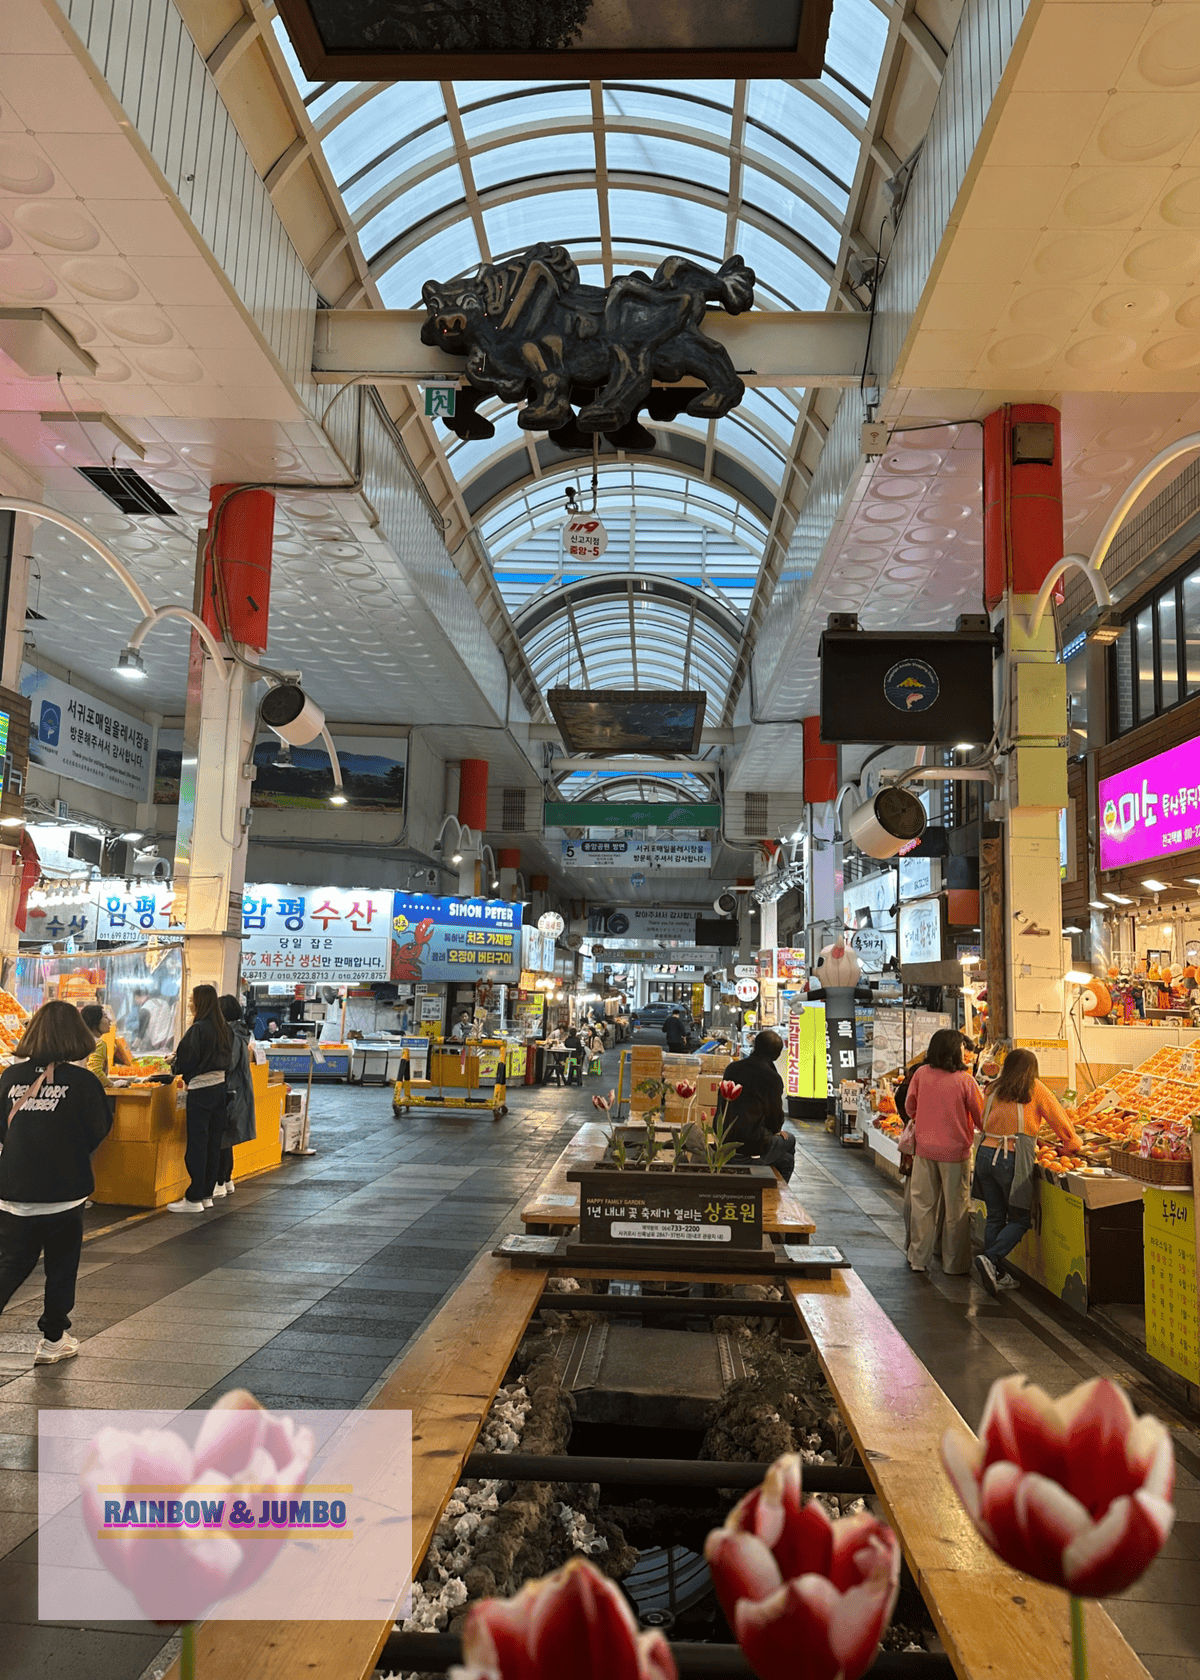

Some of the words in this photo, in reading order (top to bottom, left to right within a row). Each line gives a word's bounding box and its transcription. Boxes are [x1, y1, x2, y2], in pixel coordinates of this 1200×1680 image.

[570, 521, 599, 534] 119
[570, 535, 600, 546] 신고지점
[570, 546, 600, 556] 중앙-5
[68, 699, 149, 752] 서귀포매일올레시장을
[70, 726, 110, 755] 방문해주셔서
[112, 744, 144, 769] 감사합니다.
[566, 846, 576, 858] 5
[584, 843, 610, 851] 중앙공원
[674, 855, 706, 863] 감사합니다
[242, 896, 378, 932] 함평수산
[449, 903, 482, 918] SIMON
[484, 906, 514, 921] PETER
[634, 911, 668, 919] 찾아주셔서
[280, 938, 302, 950] 당일
[310, 938, 333, 950] 잡은
[466, 932, 486, 944] 치즈
[486, 934, 513, 946] 가재빵
[260, 953, 296, 968] 제주산
[298, 954, 332, 968] 생선만
[334, 956, 384, 968] 판매합니다.
[448, 950, 476, 963] 오징어
[477, 951, 512, 964] 버터구이
[277, 972, 329, 980] 010.9223.8713
[338, 972, 387, 980] 010.2697.8757
[40, 1084, 70, 1098] YORK
[844, 1088, 858, 1096] 무료
[844, 1096, 858, 1105] 시식
[586, 1206, 602, 1218] 1년
[604, 1206, 626, 1217] 내내
[628, 1206, 638, 1219] 꽃
[640, 1208, 671, 1220] 축제가
[674, 1208, 702, 1222] 열리는
[704, 1202, 756, 1224] 상효원
[1162, 1200, 1188, 1226] 농부네
